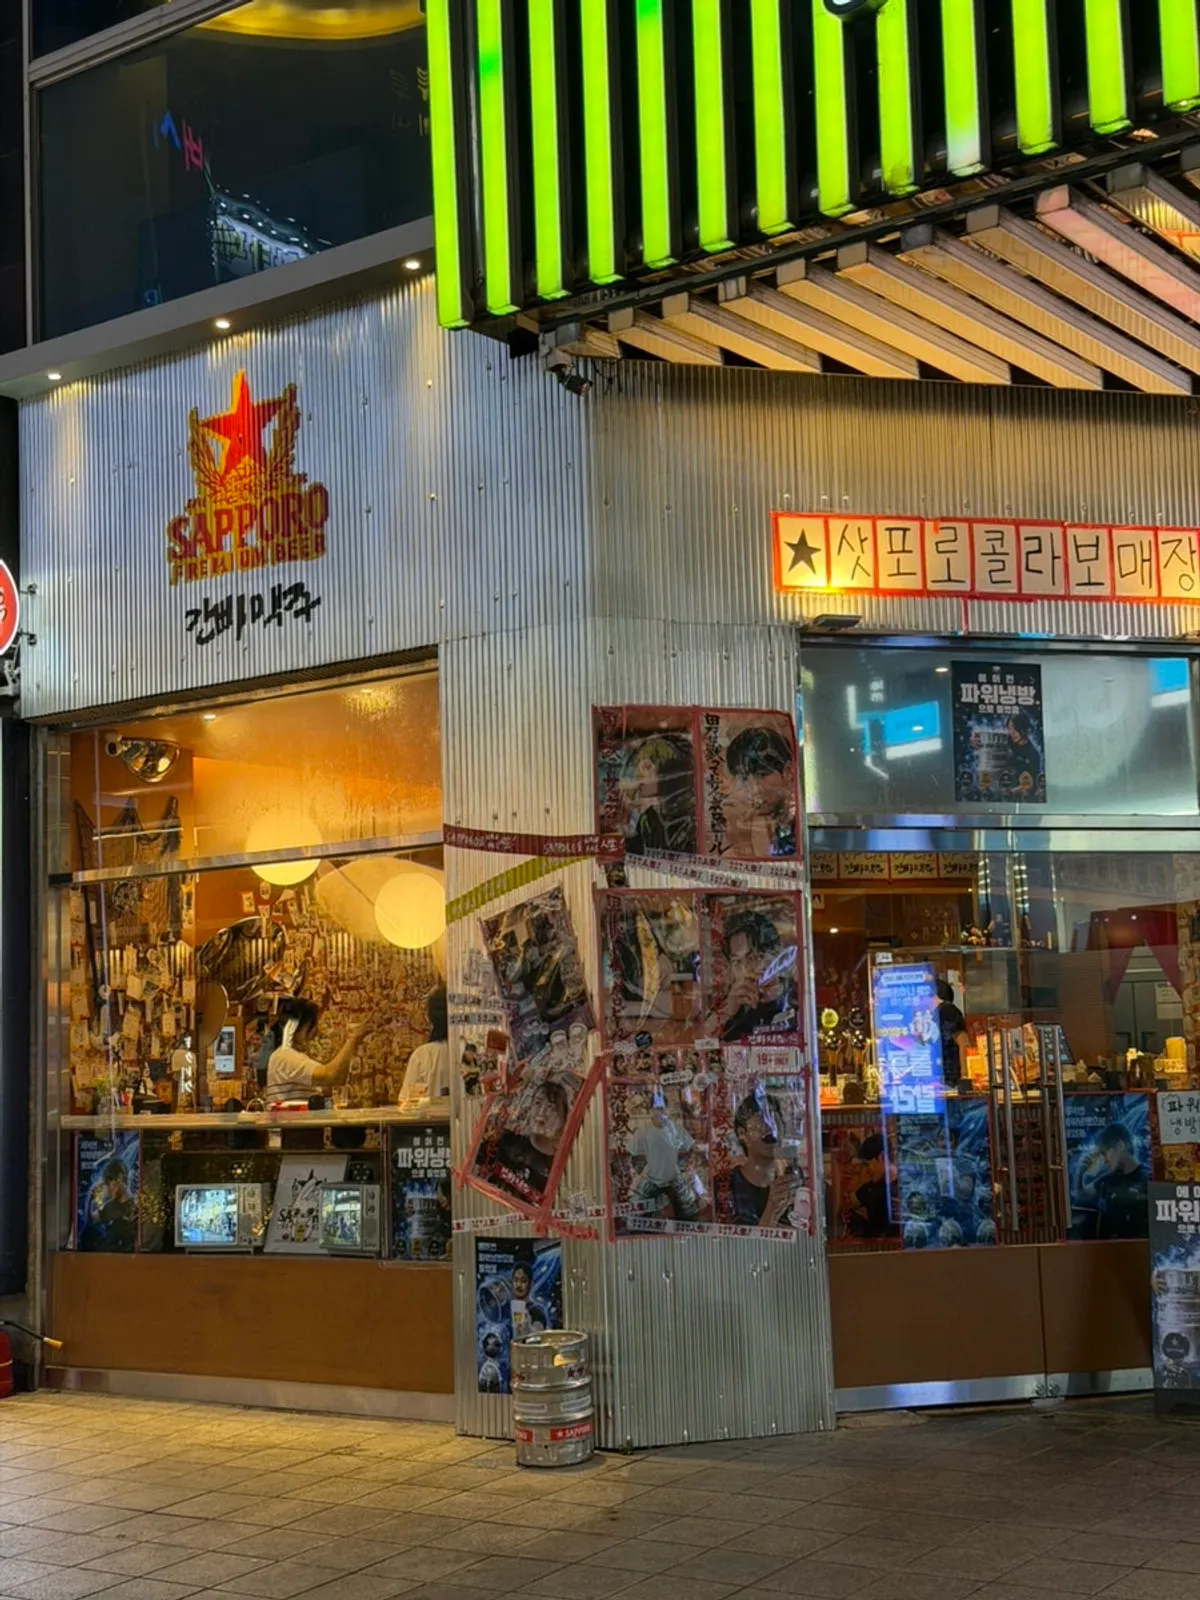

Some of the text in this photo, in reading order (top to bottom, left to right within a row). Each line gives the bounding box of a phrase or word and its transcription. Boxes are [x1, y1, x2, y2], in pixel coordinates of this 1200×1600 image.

[167, 482, 329, 560] SAPPORO
[170, 533, 326, 586] PREMIUM BEER
[836, 522, 1198, 592] 삿포로콜라보매장
